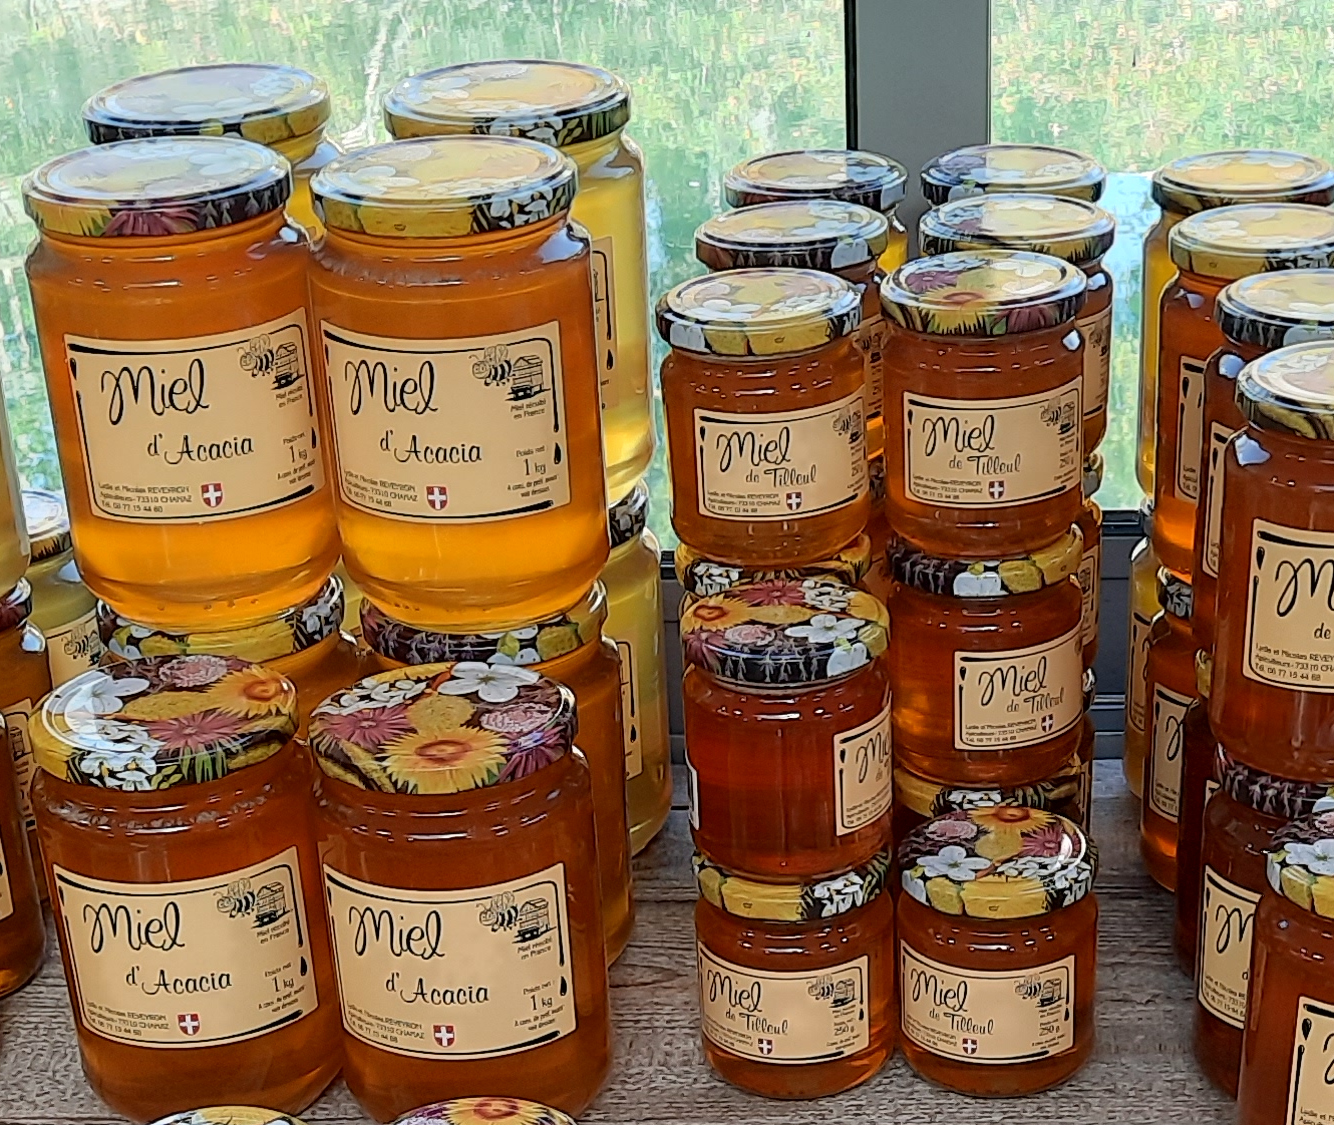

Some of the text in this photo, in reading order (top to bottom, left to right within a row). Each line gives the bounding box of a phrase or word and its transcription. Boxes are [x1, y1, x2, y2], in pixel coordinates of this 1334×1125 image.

[100, 358, 210, 425] Miel
[344, 359, 439, 415] Miel
[147, 433, 254, 465] d'Acacia
[380, 429, 482, 464] d'Acacia
[716, 426, 791, 472] Miel
[922, 414, 996, 457] Miel
[763, 464, 817, 488] Tilleul
[1313, 622, 1331, 640] de
[978, 655, 1047, 706] Miel
[83, 900, 186, 954] Miel
[348, 905, 446, 961] Miel
[125, 965, 232, 996] d'Acacia
[385, 972, 490, 1005] d'Acacia
[707, 969, 763, 1013] Miel
[910, 967, 969, 1013] Miel
